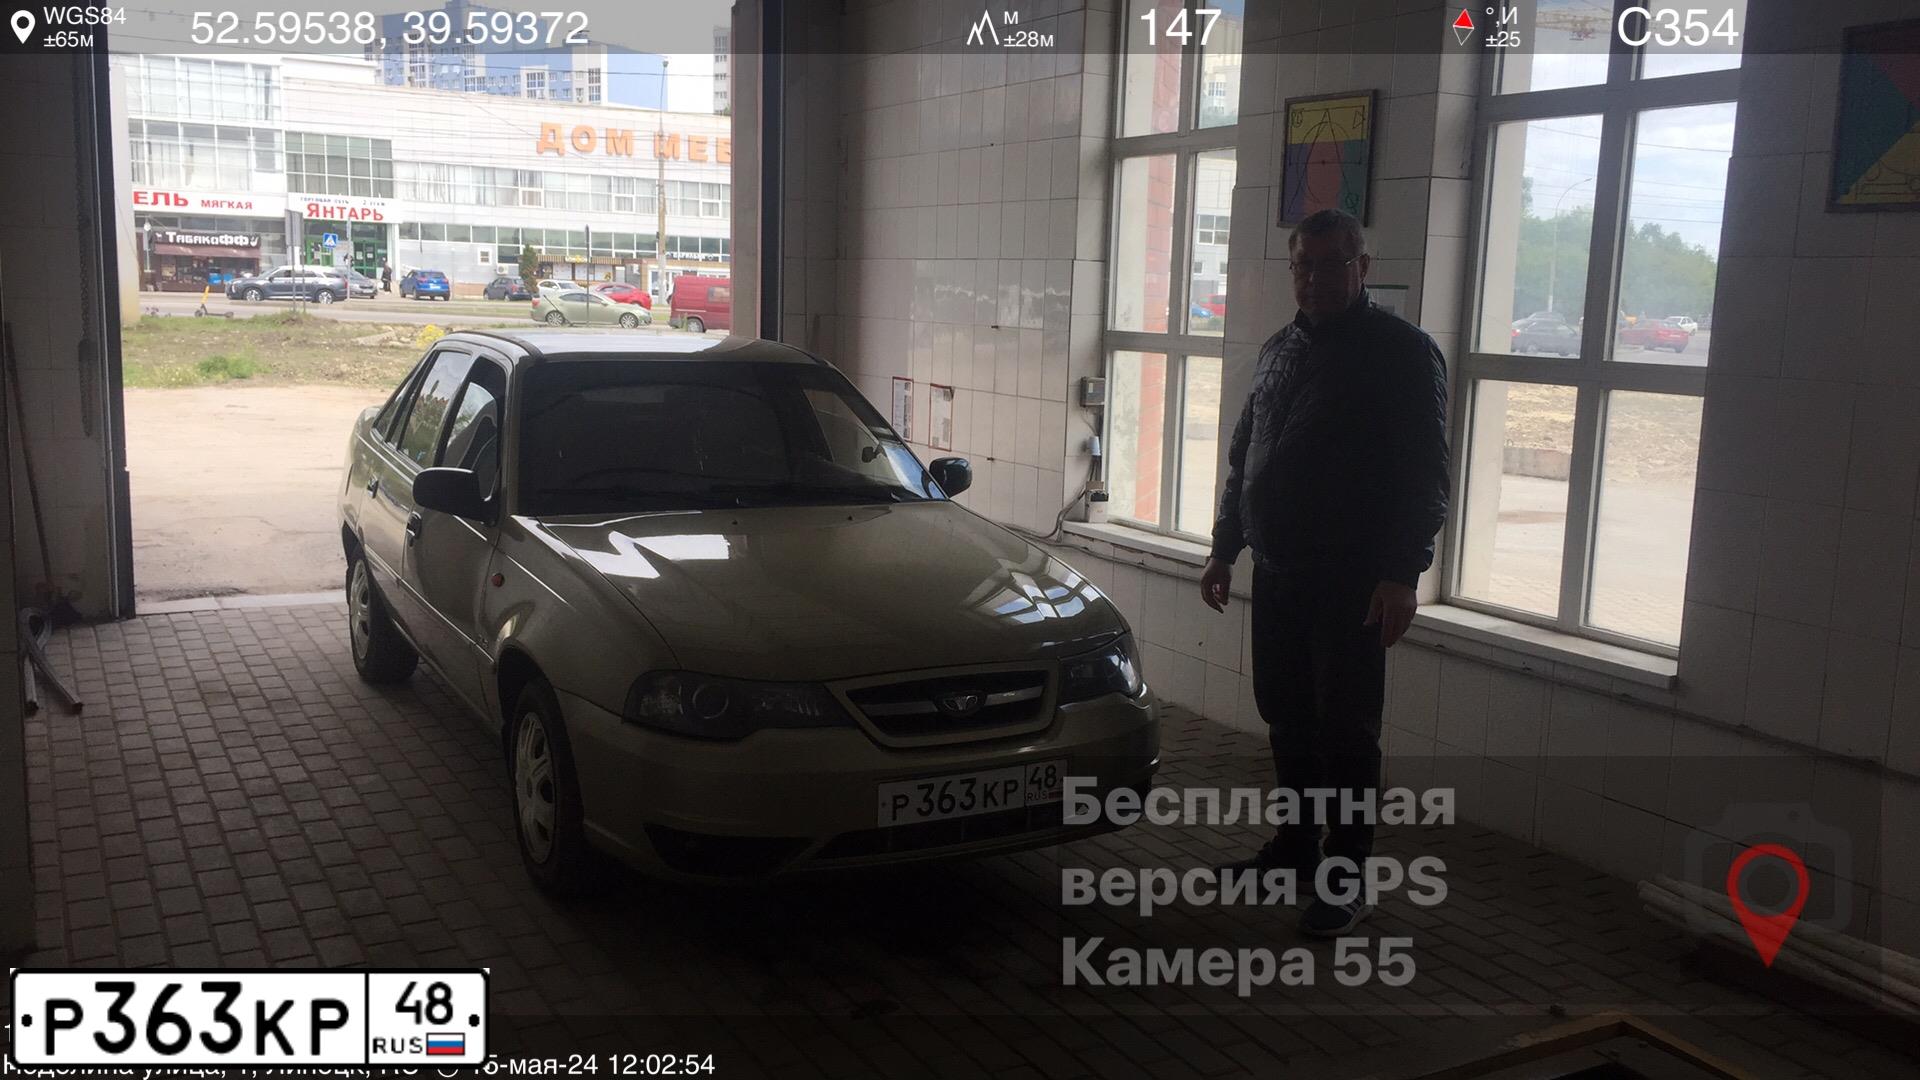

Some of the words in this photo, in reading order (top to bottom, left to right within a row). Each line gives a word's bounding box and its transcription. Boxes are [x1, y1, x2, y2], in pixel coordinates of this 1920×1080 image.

[536, 122, 634, 157] ДОМ
[133, 190, 189, 207] ЕЛЬ
[200, 199, 253, 210] МЯГКАЯ
[307, 203, 384, 221] ЯНТАРЬ
[892, 777, 1019, 821] Р363КР
[1029, 764, 1057, 791] 48
[1026, 790, 1048, 801] RUS
